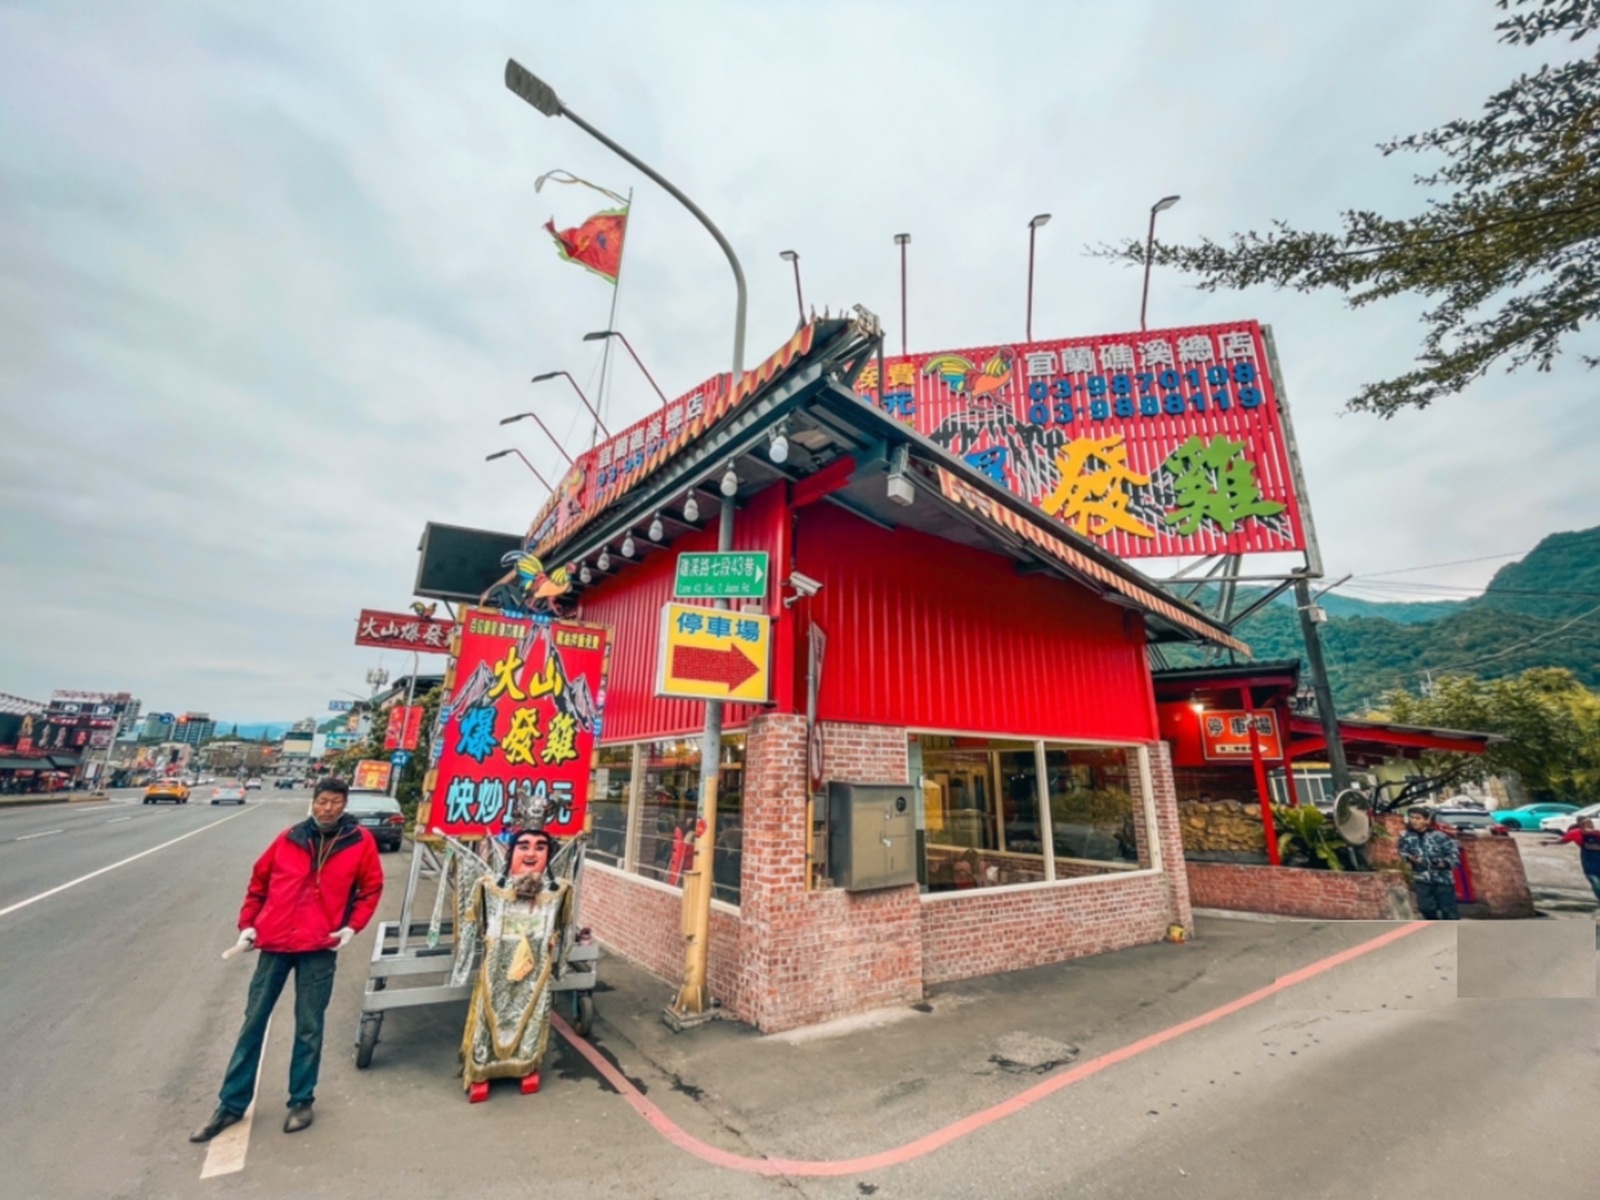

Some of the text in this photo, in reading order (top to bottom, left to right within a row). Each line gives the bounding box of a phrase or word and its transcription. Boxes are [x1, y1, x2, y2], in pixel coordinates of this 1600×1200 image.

[1026, 331, 1255, 377] 宜蘭礁溪總店
[677, 611, 761, 642] 停車場
[488, 645, 564, 702] 火山
[455, 705, 579, 767] 爆發雞
[1207, 715, 1273, 737] 停車場
